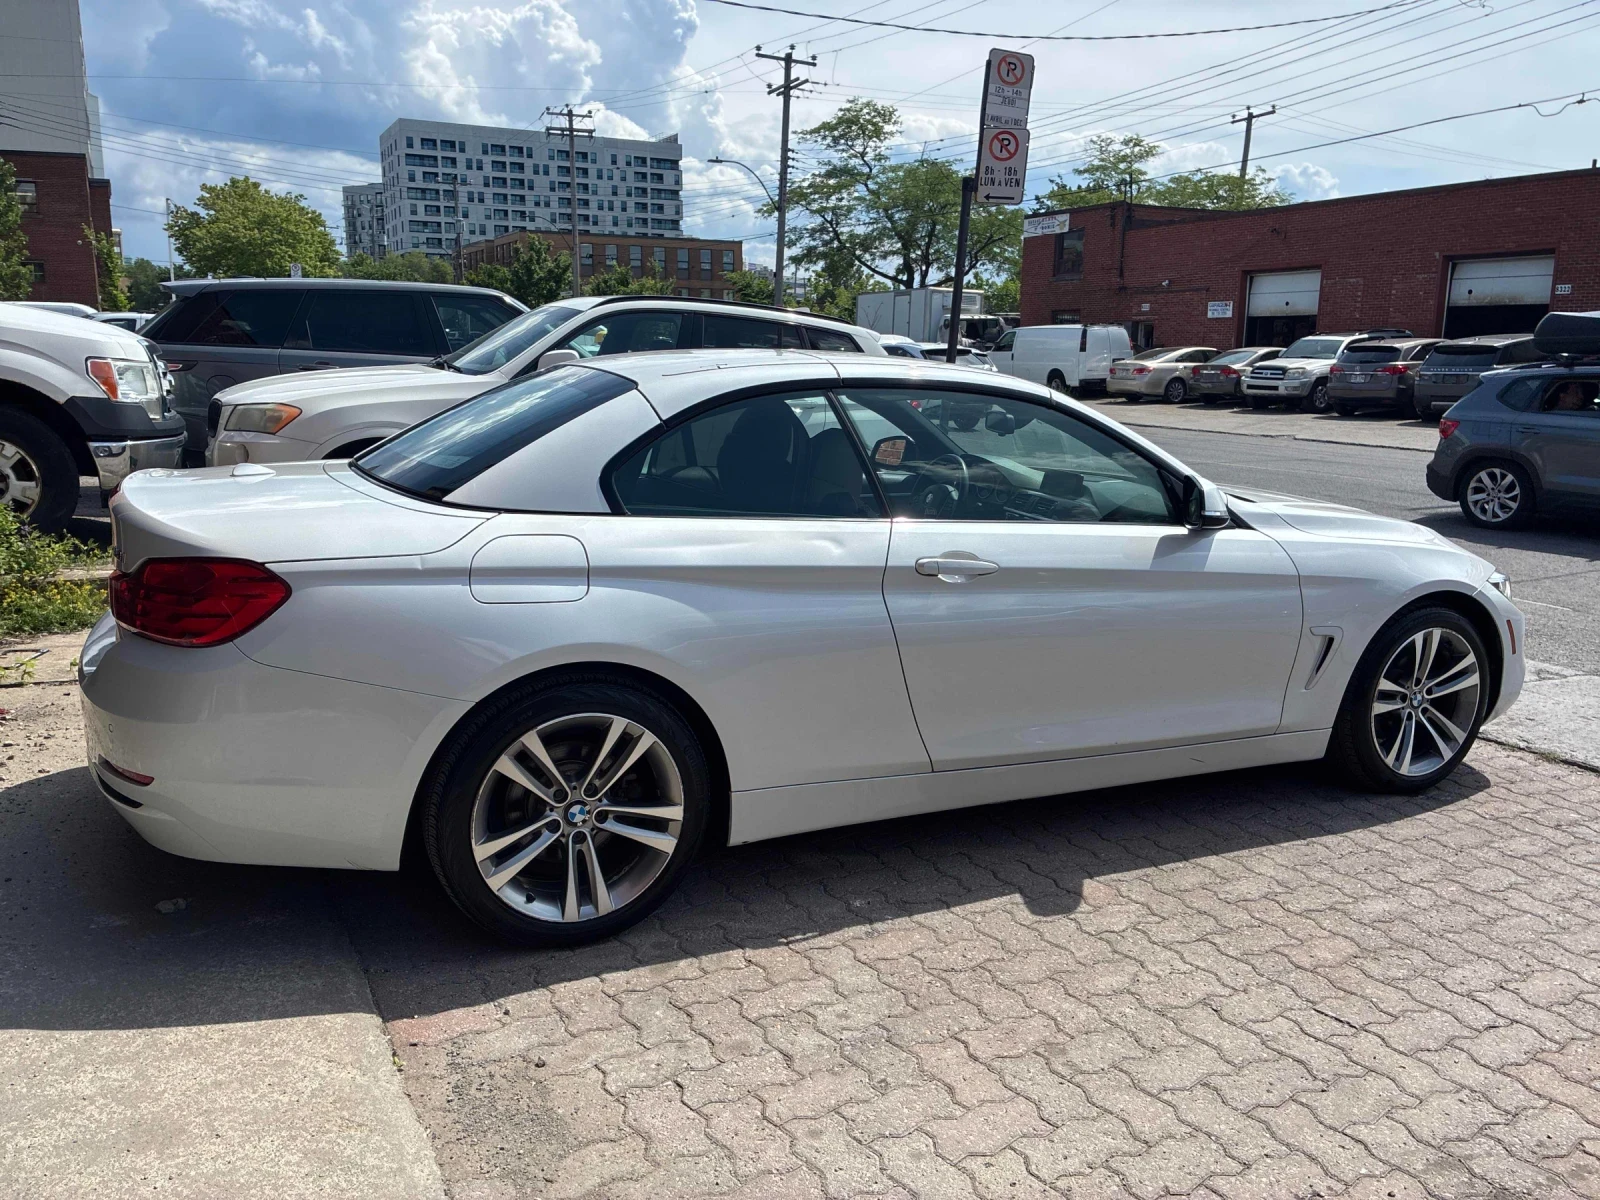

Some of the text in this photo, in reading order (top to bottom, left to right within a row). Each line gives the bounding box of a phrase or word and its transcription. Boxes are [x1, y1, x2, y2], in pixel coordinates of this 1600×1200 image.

[995, 86, 1005, 94] 12h
[1012, 88, 1022, 96] 14h
[990, 115, 1003, 124] AVRIL
[985, 165, 994, 175] 8h
[1004, 166, 1018, 176] 18h
[980, 176, 995, 186] LUN
[1004, 177, 1020, 187] VEN
